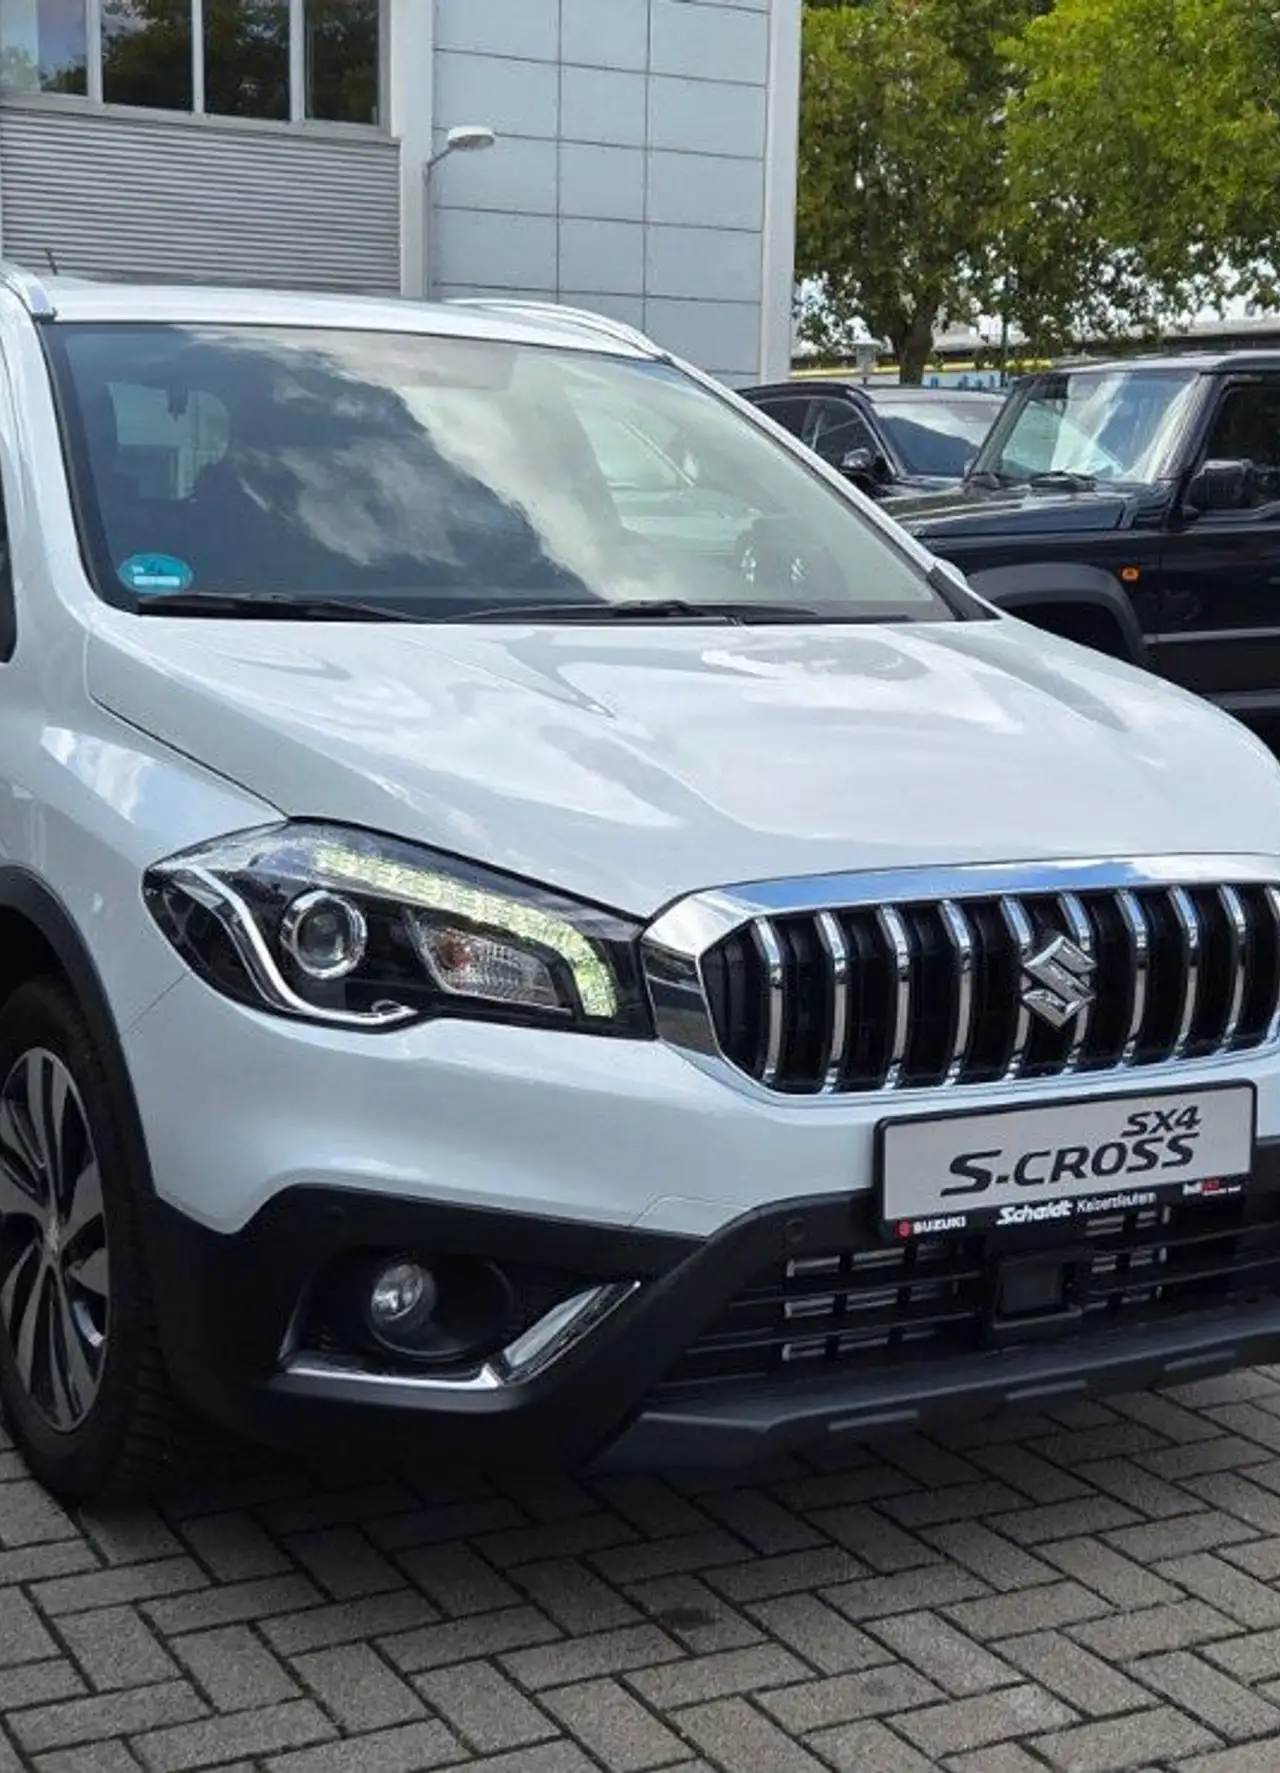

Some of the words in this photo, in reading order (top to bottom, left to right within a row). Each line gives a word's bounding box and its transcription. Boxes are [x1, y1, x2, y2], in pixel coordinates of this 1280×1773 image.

[1121, 1105, 1201, 1138] SX4
[939, 1132, 1200, 1198] S-CROSS
[913, 1215, 967, 1235] SUZUKI
